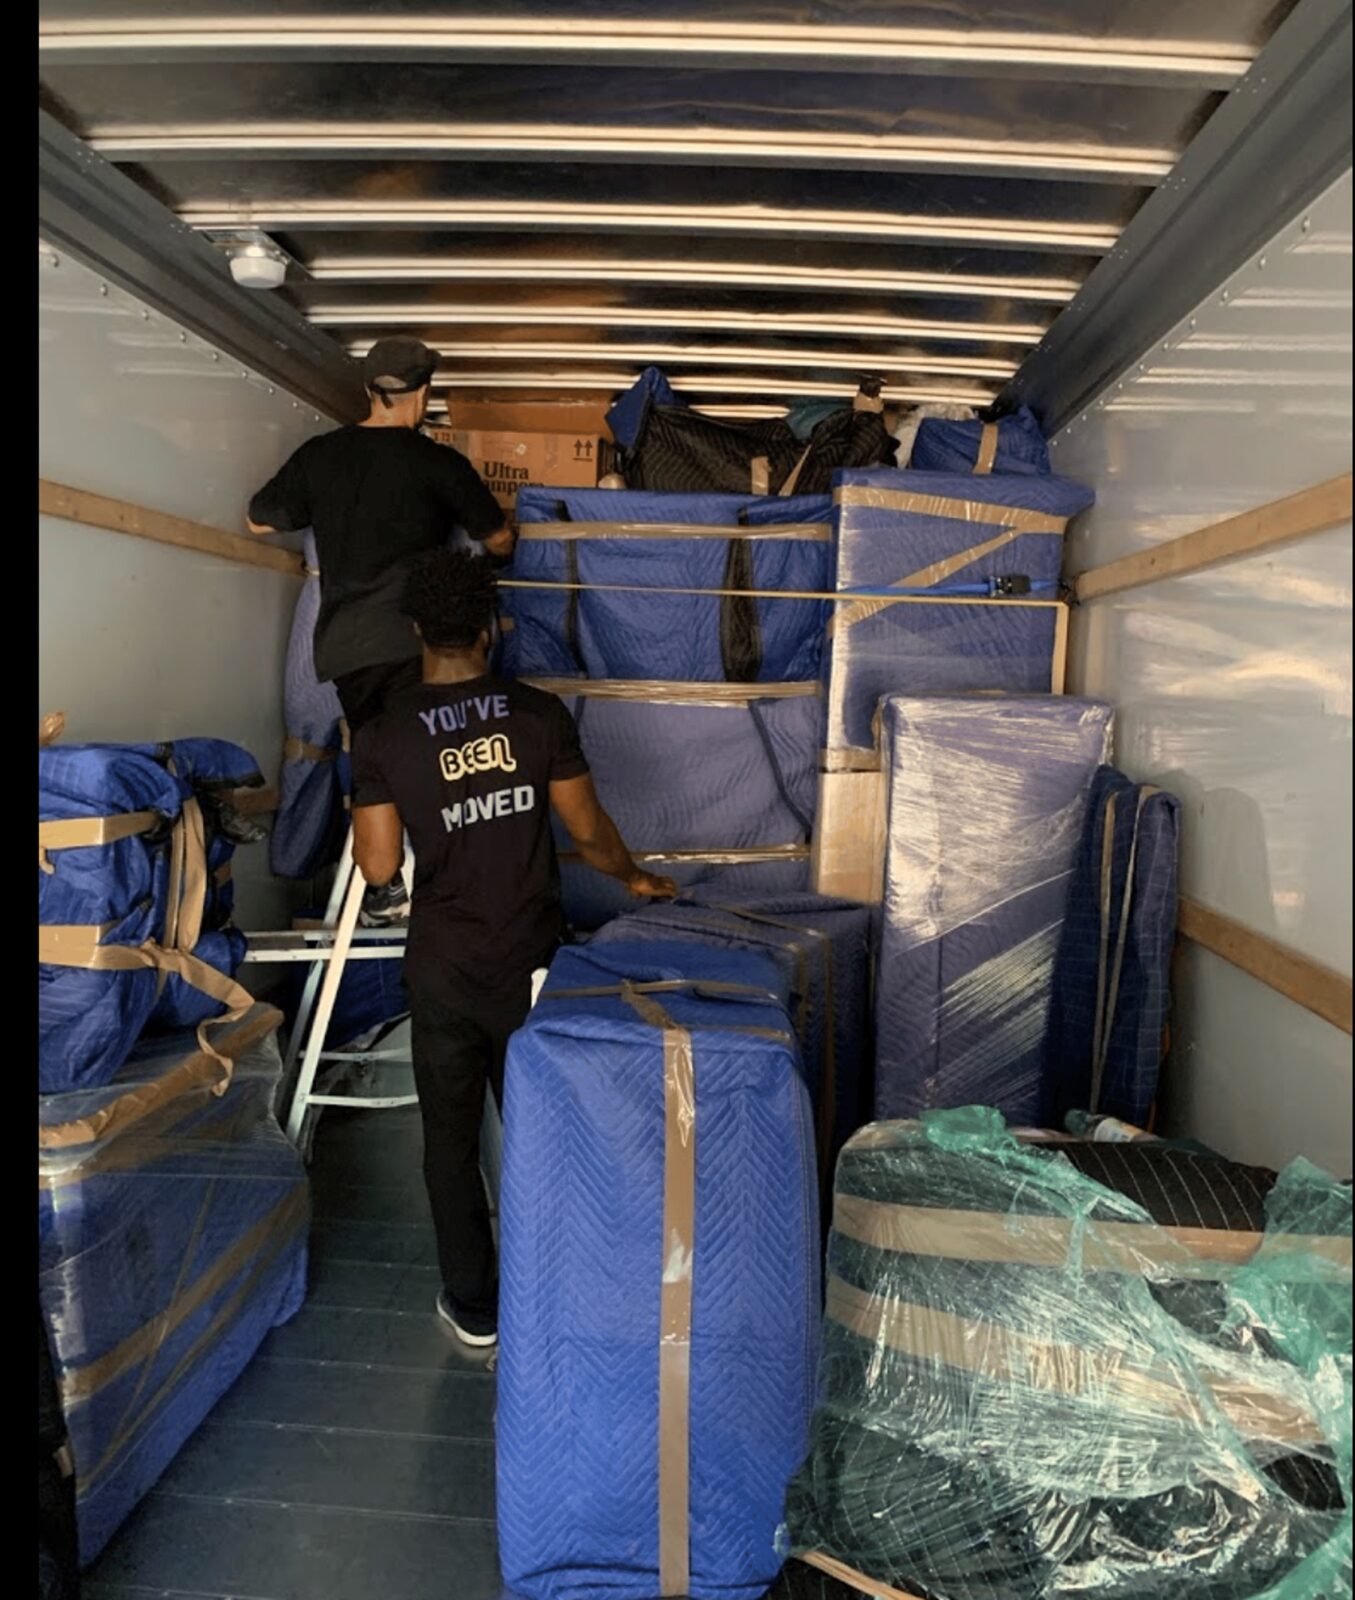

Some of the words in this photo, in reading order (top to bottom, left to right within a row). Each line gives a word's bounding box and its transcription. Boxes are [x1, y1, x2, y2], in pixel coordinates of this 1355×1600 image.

[483, 461, 529, 480] Ultra
[418, 694, 510, 736] YOU'VE
[439, 733, 517, 781] BEEN
[440, 784, 535, 833] MOVED
